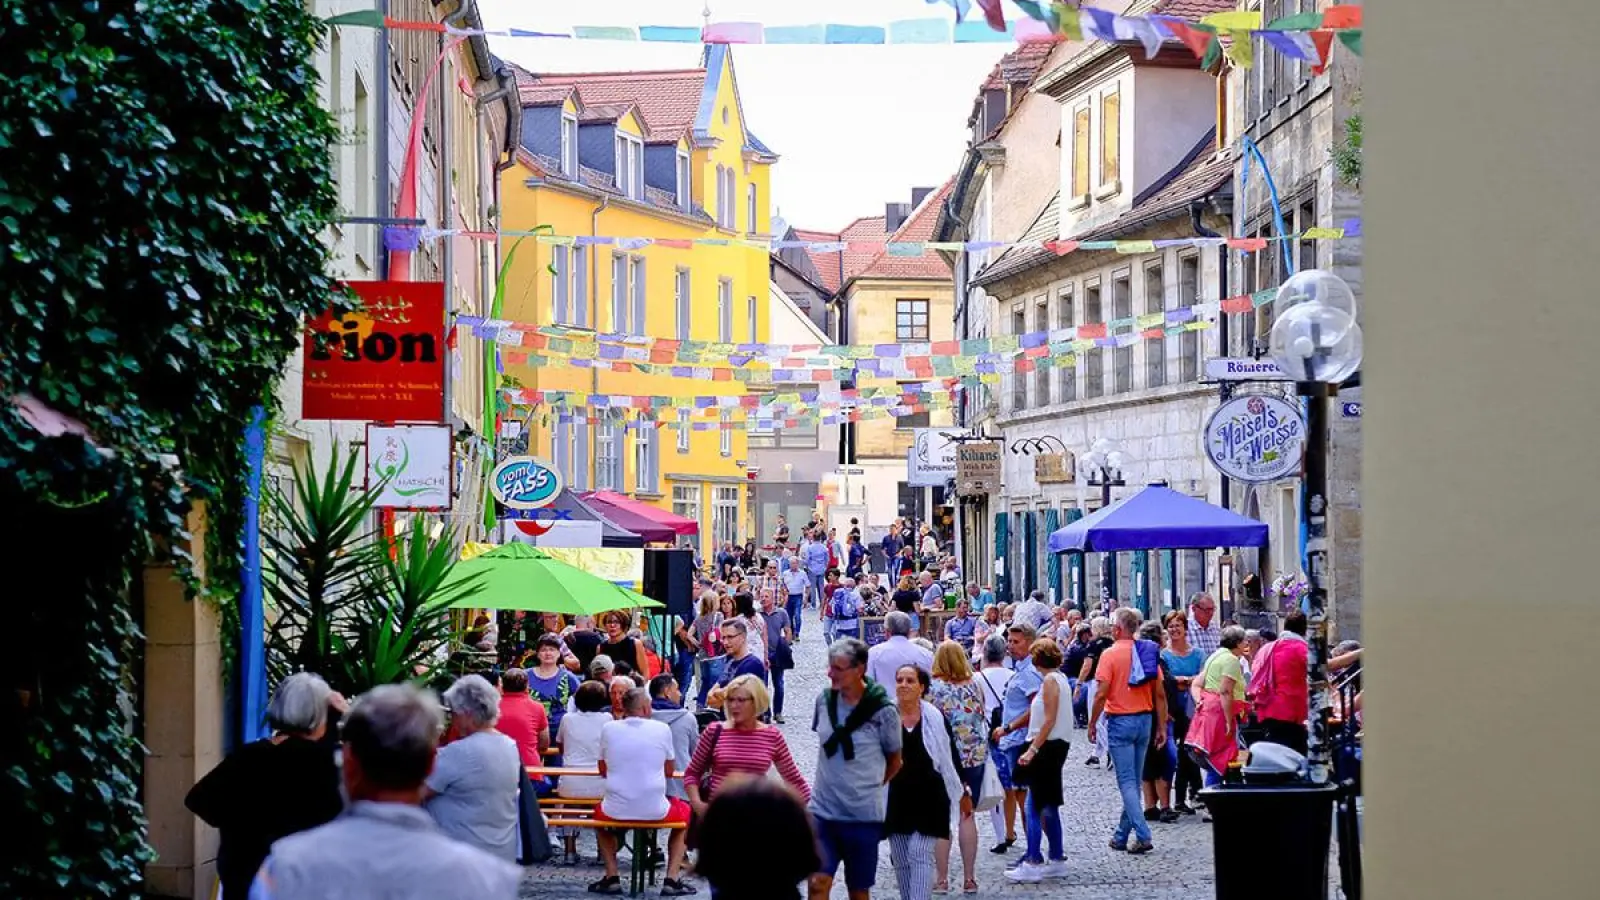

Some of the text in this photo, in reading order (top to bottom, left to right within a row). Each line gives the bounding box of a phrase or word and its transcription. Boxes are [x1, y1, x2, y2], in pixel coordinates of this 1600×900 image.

[1216, 405, 1279, 461] Maisel's
[1240, 419, 1299, 463] Weisse
[501, 468, 549, 503] FASS
[502, 466, 527, 483] vom
